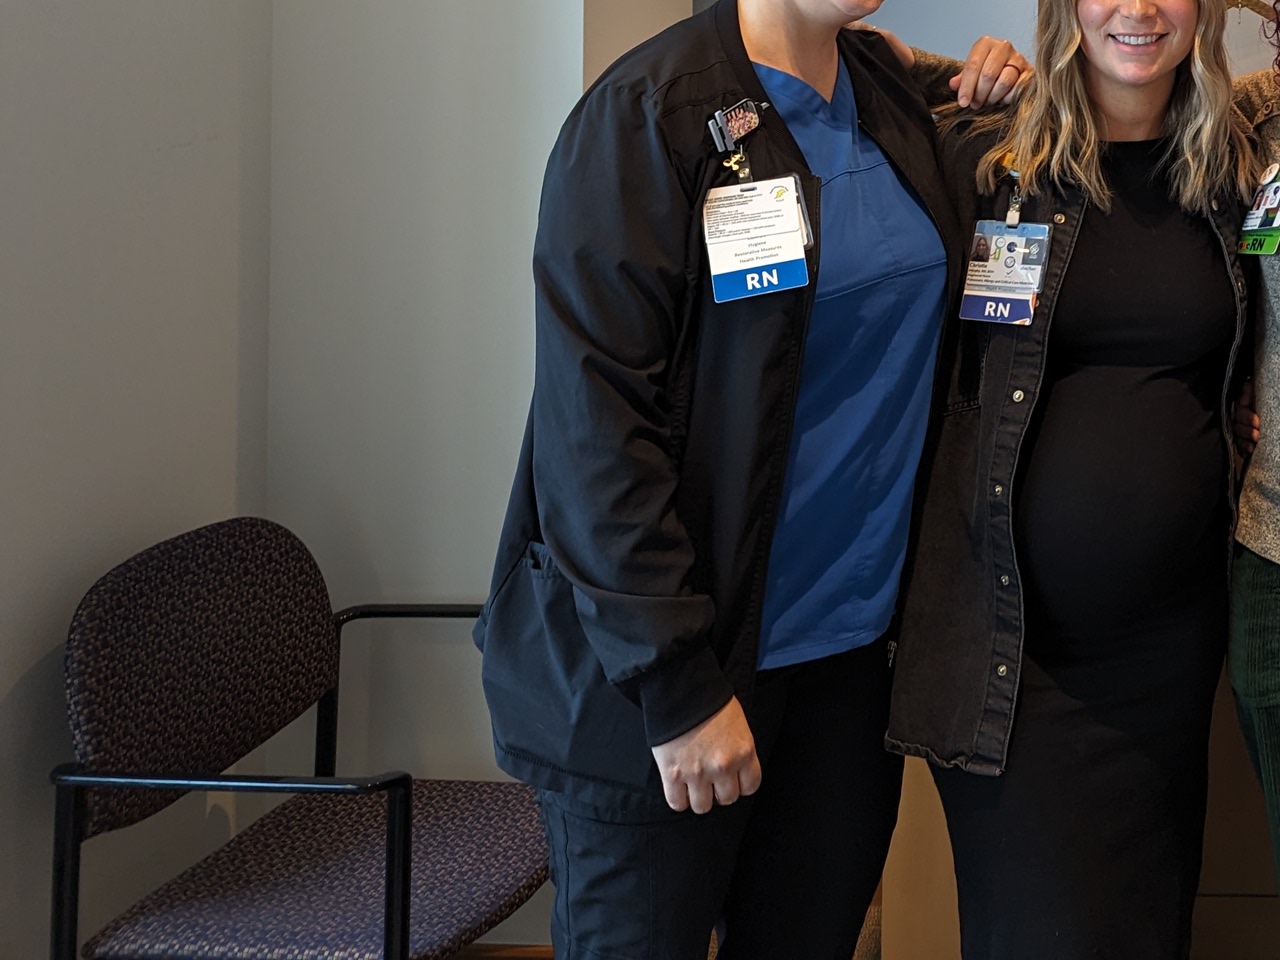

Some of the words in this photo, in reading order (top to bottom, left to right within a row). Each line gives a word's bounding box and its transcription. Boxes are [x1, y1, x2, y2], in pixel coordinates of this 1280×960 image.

[1250, 238, 1266, 251] RN
[734, 249, 760, 257] Restorative
[746, 269, 778, 290] RN
[985, 301, 1010, 317] RN
